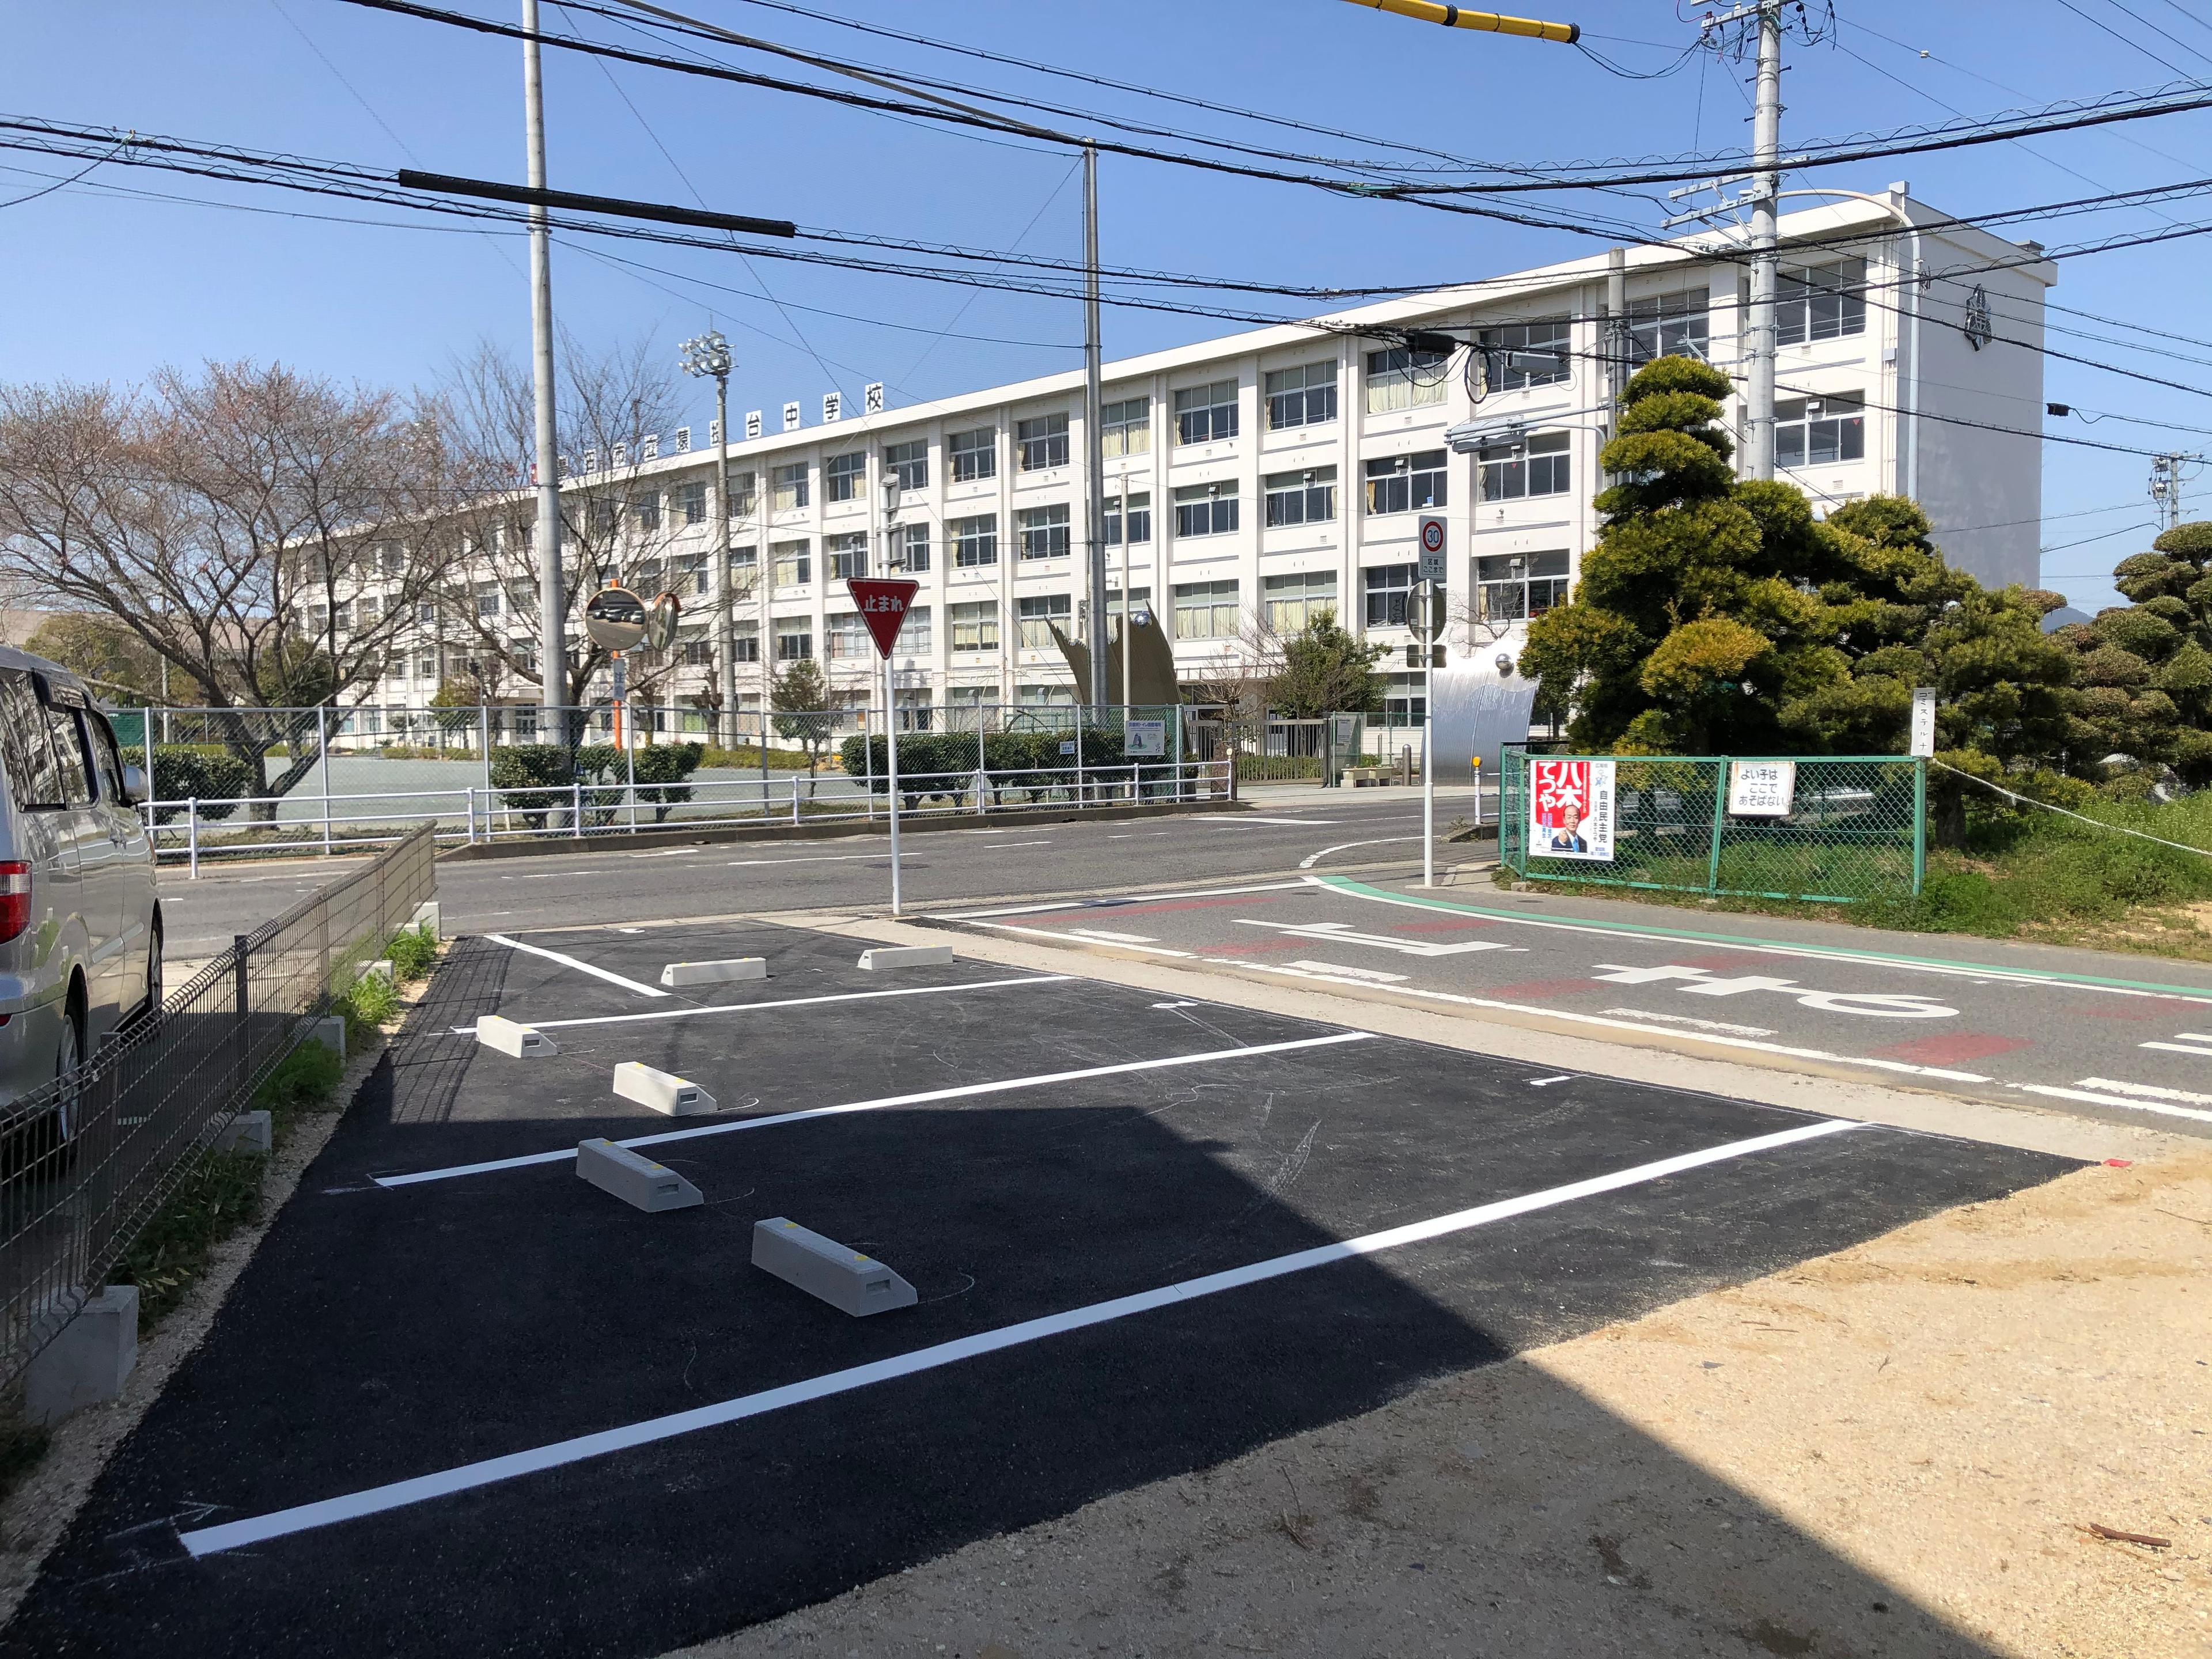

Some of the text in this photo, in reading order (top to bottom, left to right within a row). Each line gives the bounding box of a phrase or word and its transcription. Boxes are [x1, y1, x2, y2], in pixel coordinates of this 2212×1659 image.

[1427, 529, 1439, 543] 30
[863, 594, 904, 612] 止まれ
[1918, 692, 1933, 751] ゴミステルナ
[1741, 769, 1778, 781] よい子は
[1539, 762, 1556, 812] てつや
[1556, 762, 1583, 809] 八木
[1749, 783, 1778, 794] ここで
[1738, 795, 1785, 806] あそばない
[1599, 790, 1608, 843] 自由民主党
